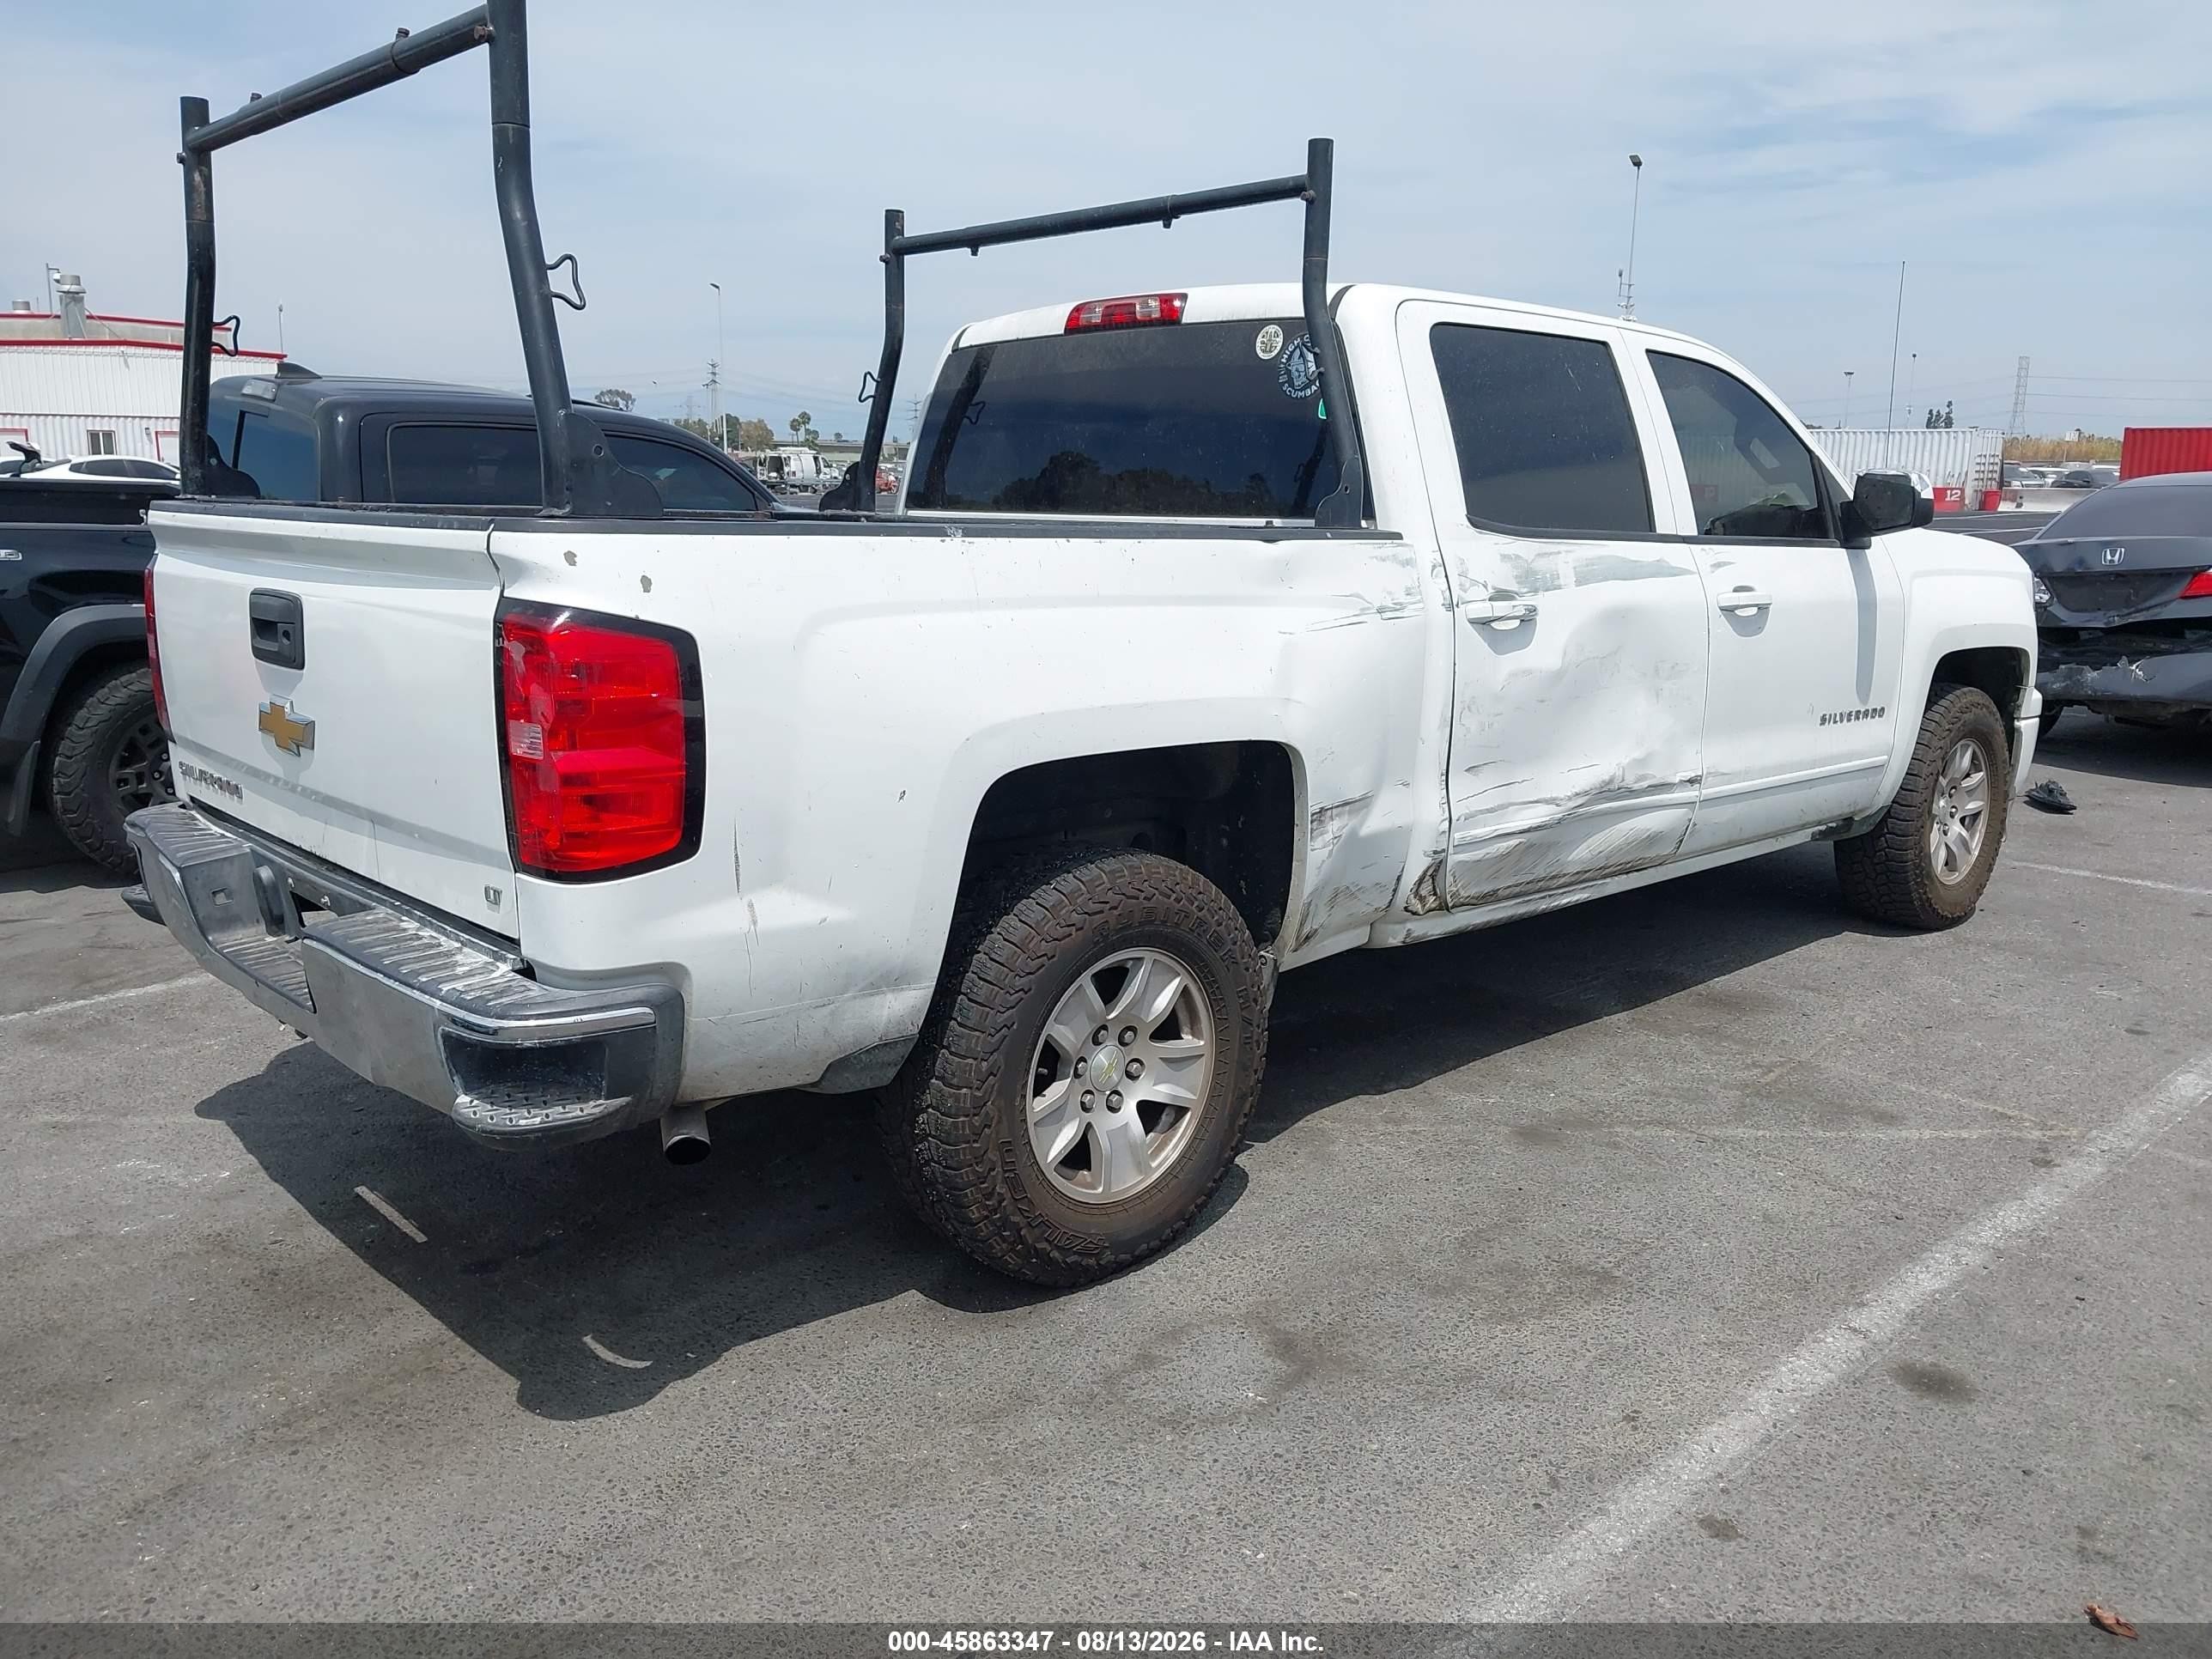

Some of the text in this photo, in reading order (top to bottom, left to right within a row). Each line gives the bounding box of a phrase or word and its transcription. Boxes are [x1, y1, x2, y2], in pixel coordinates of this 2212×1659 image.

[1280, 337, 1301, 363] HIGH
[1944, 489, 1961, 501] 12
[1819, 706, 1886, 726] SILVERADO
